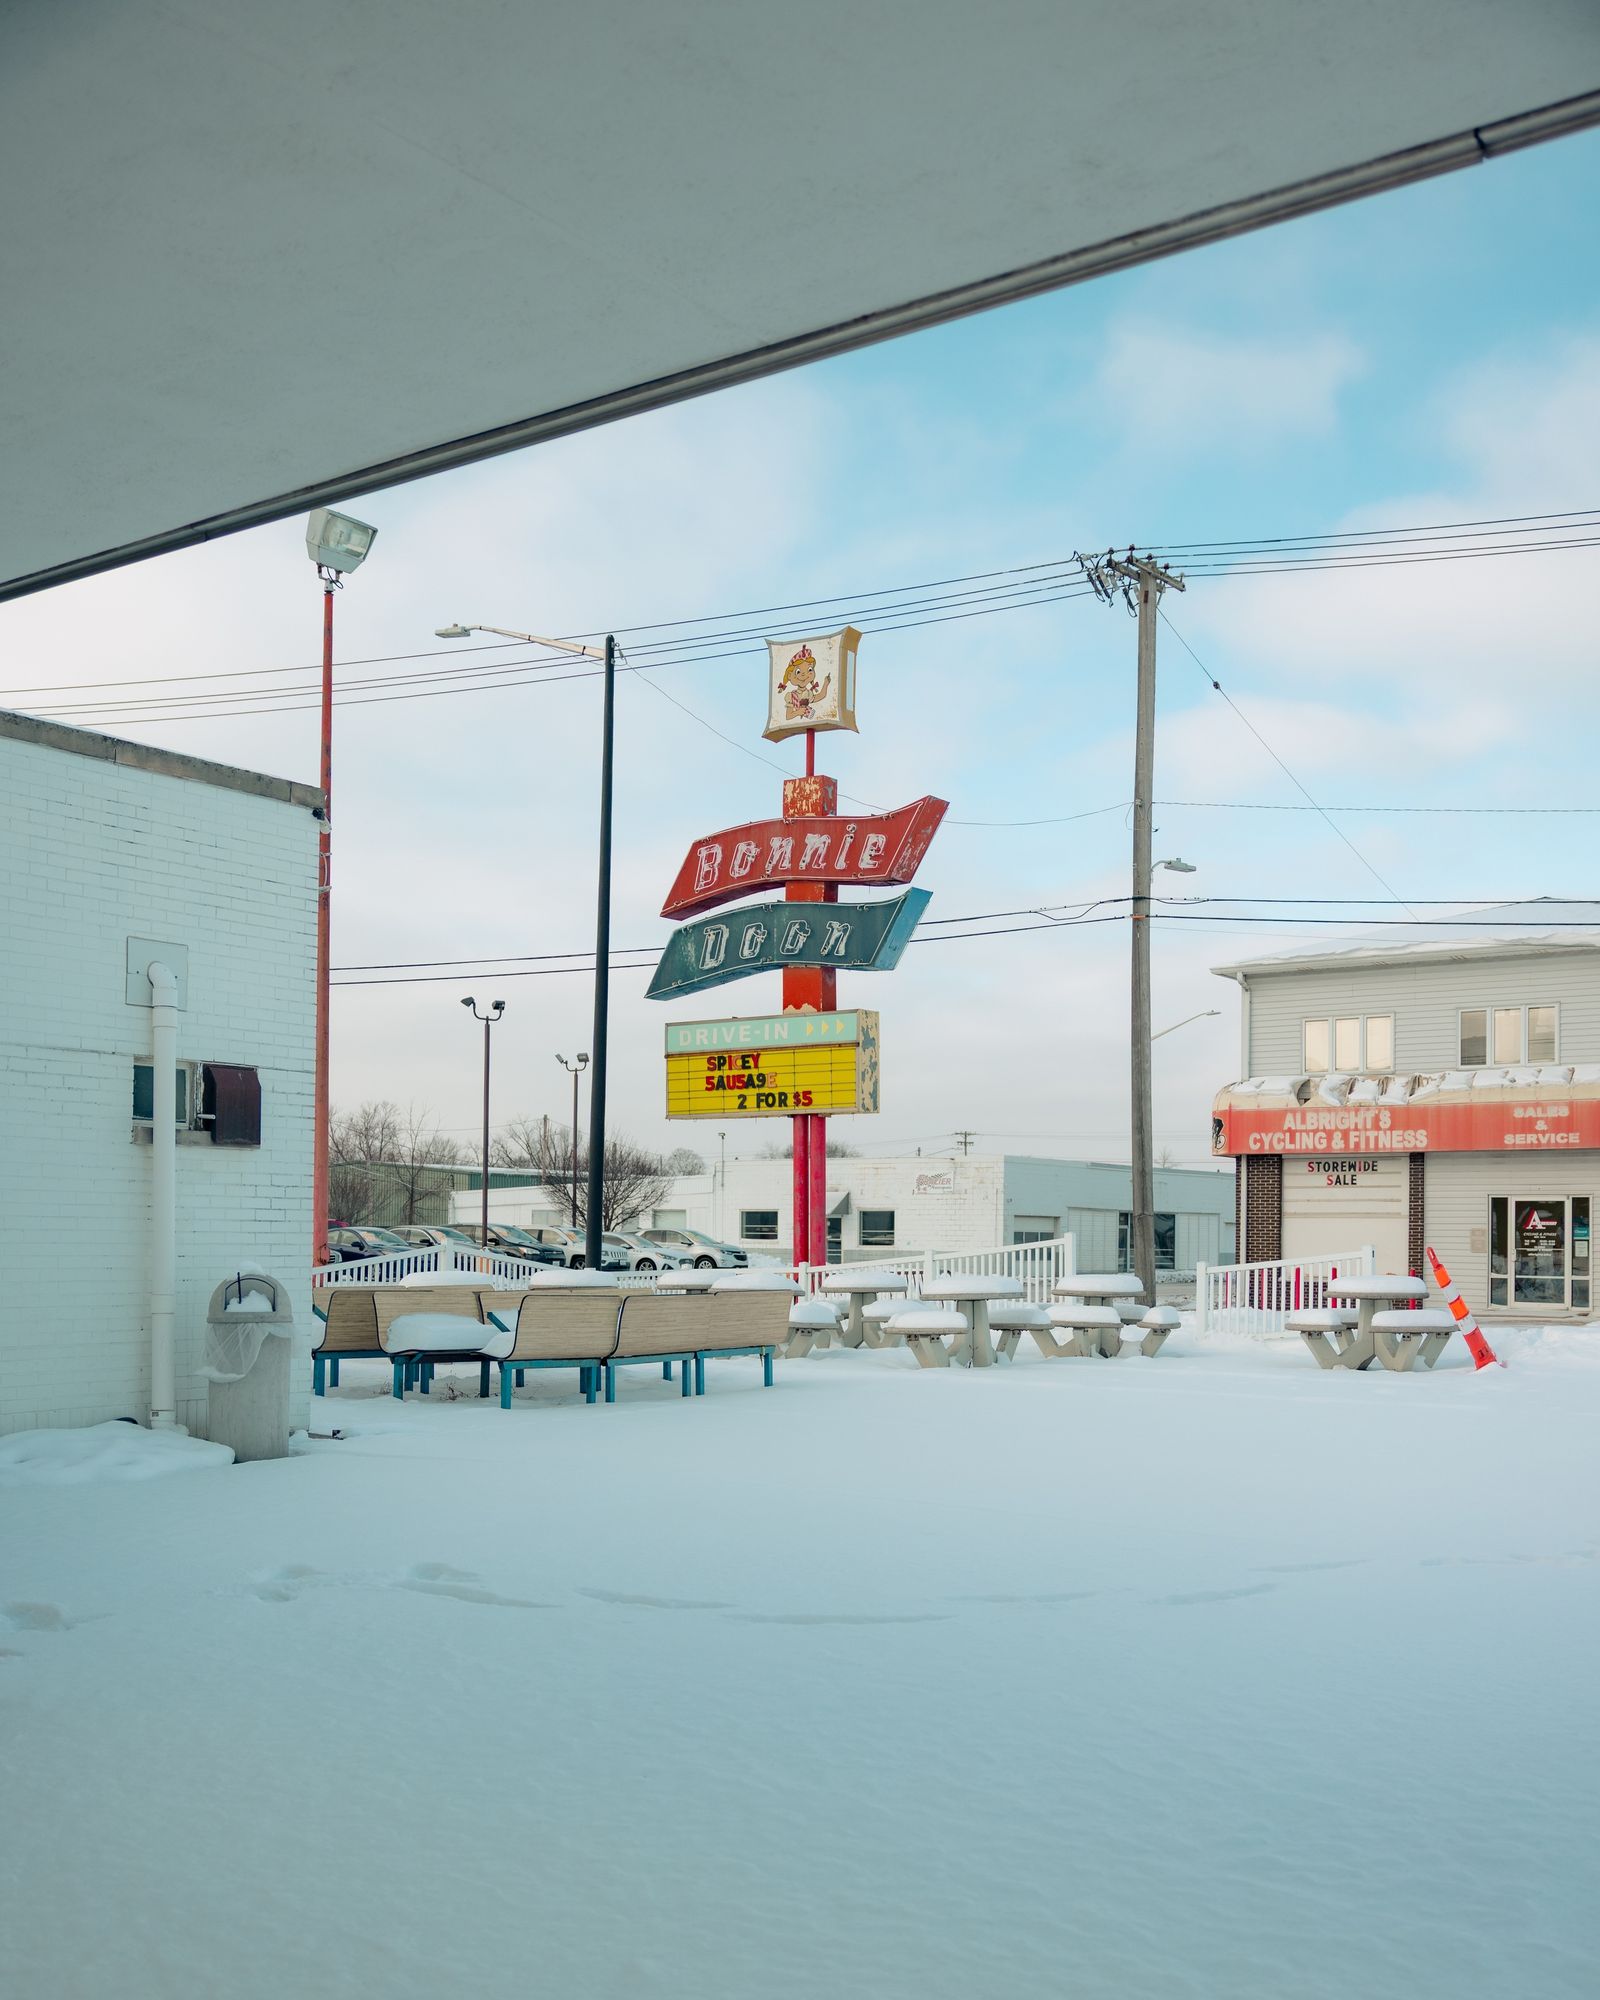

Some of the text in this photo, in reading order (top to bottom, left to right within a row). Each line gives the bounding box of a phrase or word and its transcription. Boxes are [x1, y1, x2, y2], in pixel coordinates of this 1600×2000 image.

[693, 823, 887, 893] Bonnie
[699, 919, 851, 970] Doon
[679, 1022, 788, 1047] DRIVE-IN
[706, 1052, 761, 1072] SPICEY
[737, 1090, 813, 1110] 2 FOR $5
[1283, 1109, 1391, 1131] ALBRIGHT'S
[1513, 1105, 1569, 1118] SALES
[1535, 1119, 1548, 1131] &
[1249, 1129, 1428, 1151] CYCLING & FITNESS
[1503, 1132, 1580, 1145] SERVICE
[1307, 1160, 1378, 1173] STOREWIDE
[1326, 1174, 1358, 1186] SALE
